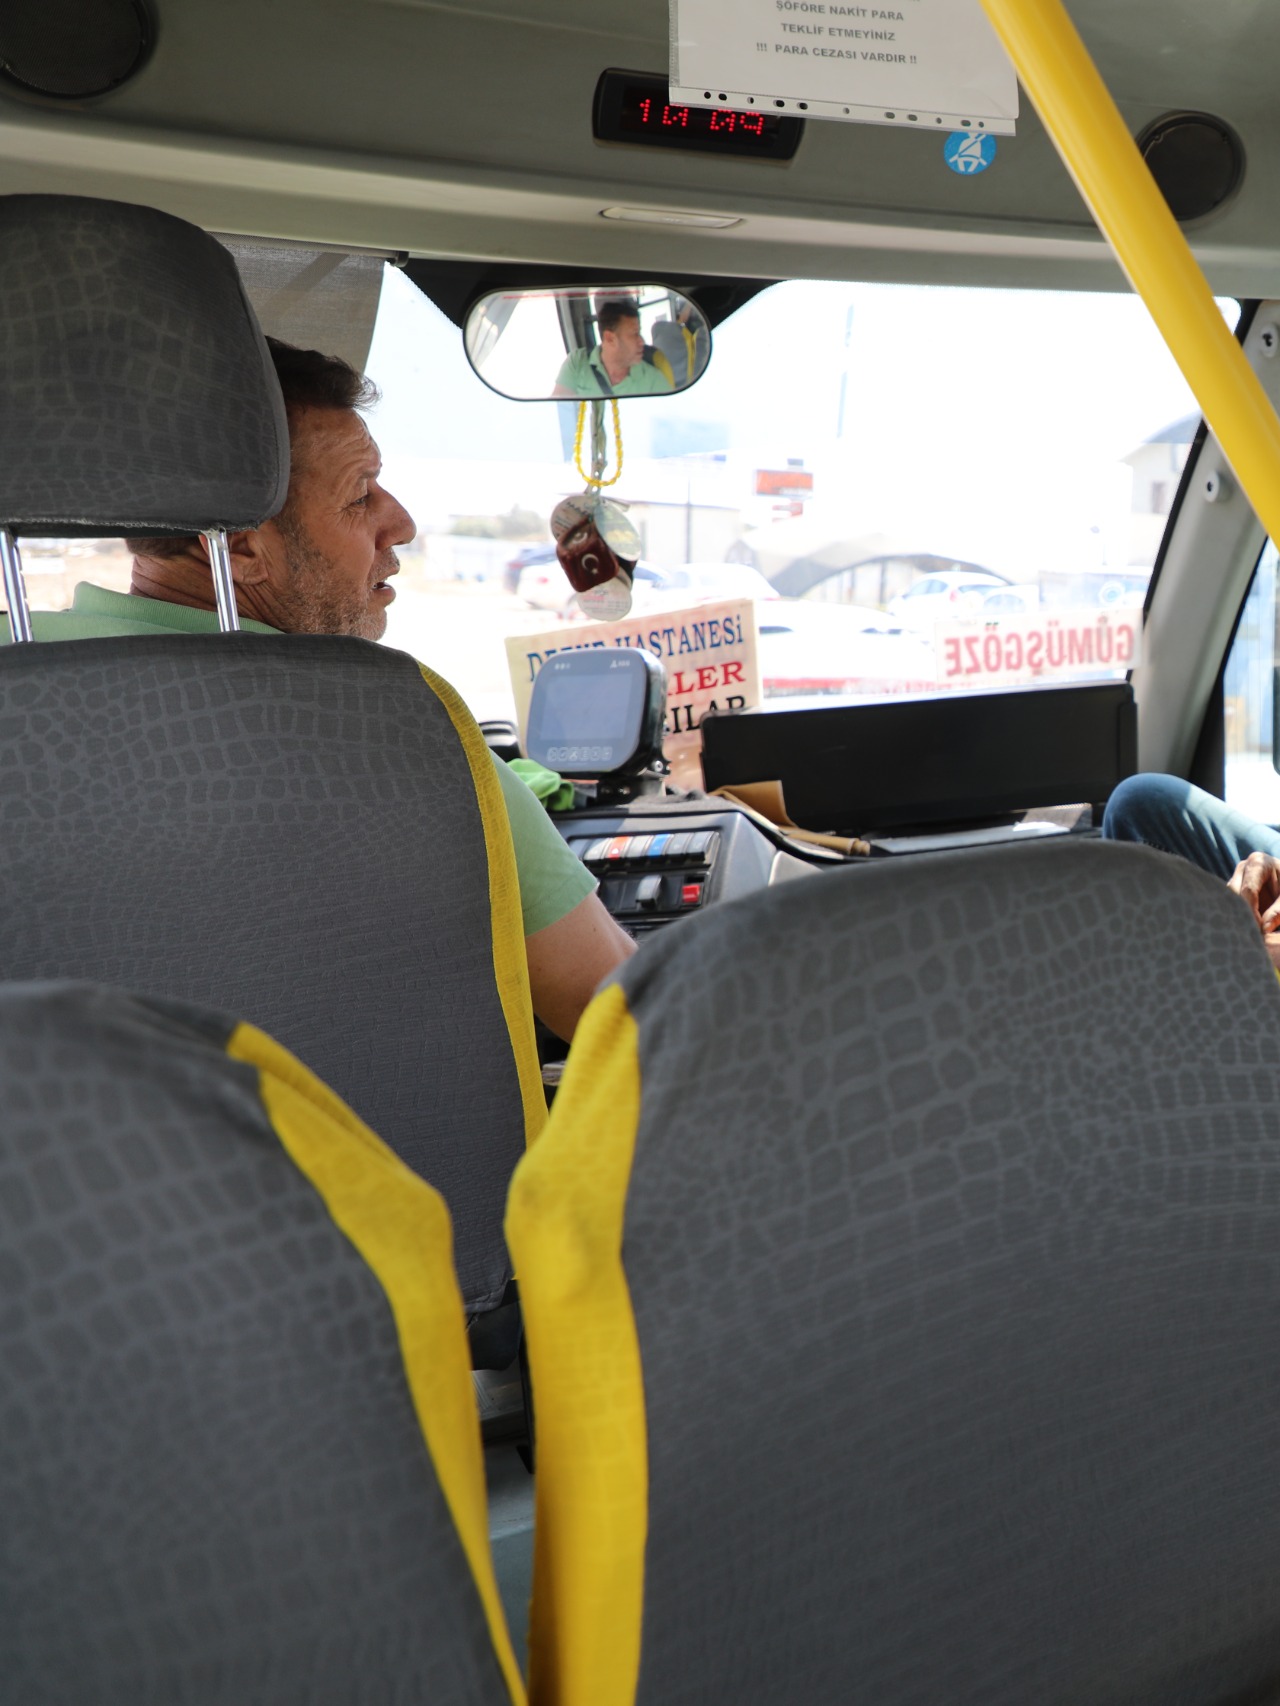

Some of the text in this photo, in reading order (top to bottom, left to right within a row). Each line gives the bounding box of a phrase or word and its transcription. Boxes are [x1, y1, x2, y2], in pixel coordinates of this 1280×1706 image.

[829, 6, 868, 18] NAKİT
[871, 10, 904, 21] PARA
[781, 22, 896, 41] TEKLİF ETMEYİNİZ
[775, 44, 809, 56] PARA
[812, 47, 857, 60] CEZASI
[861, 51, 906, 64] VARDIR
[668, 661, 746, 696] LER
